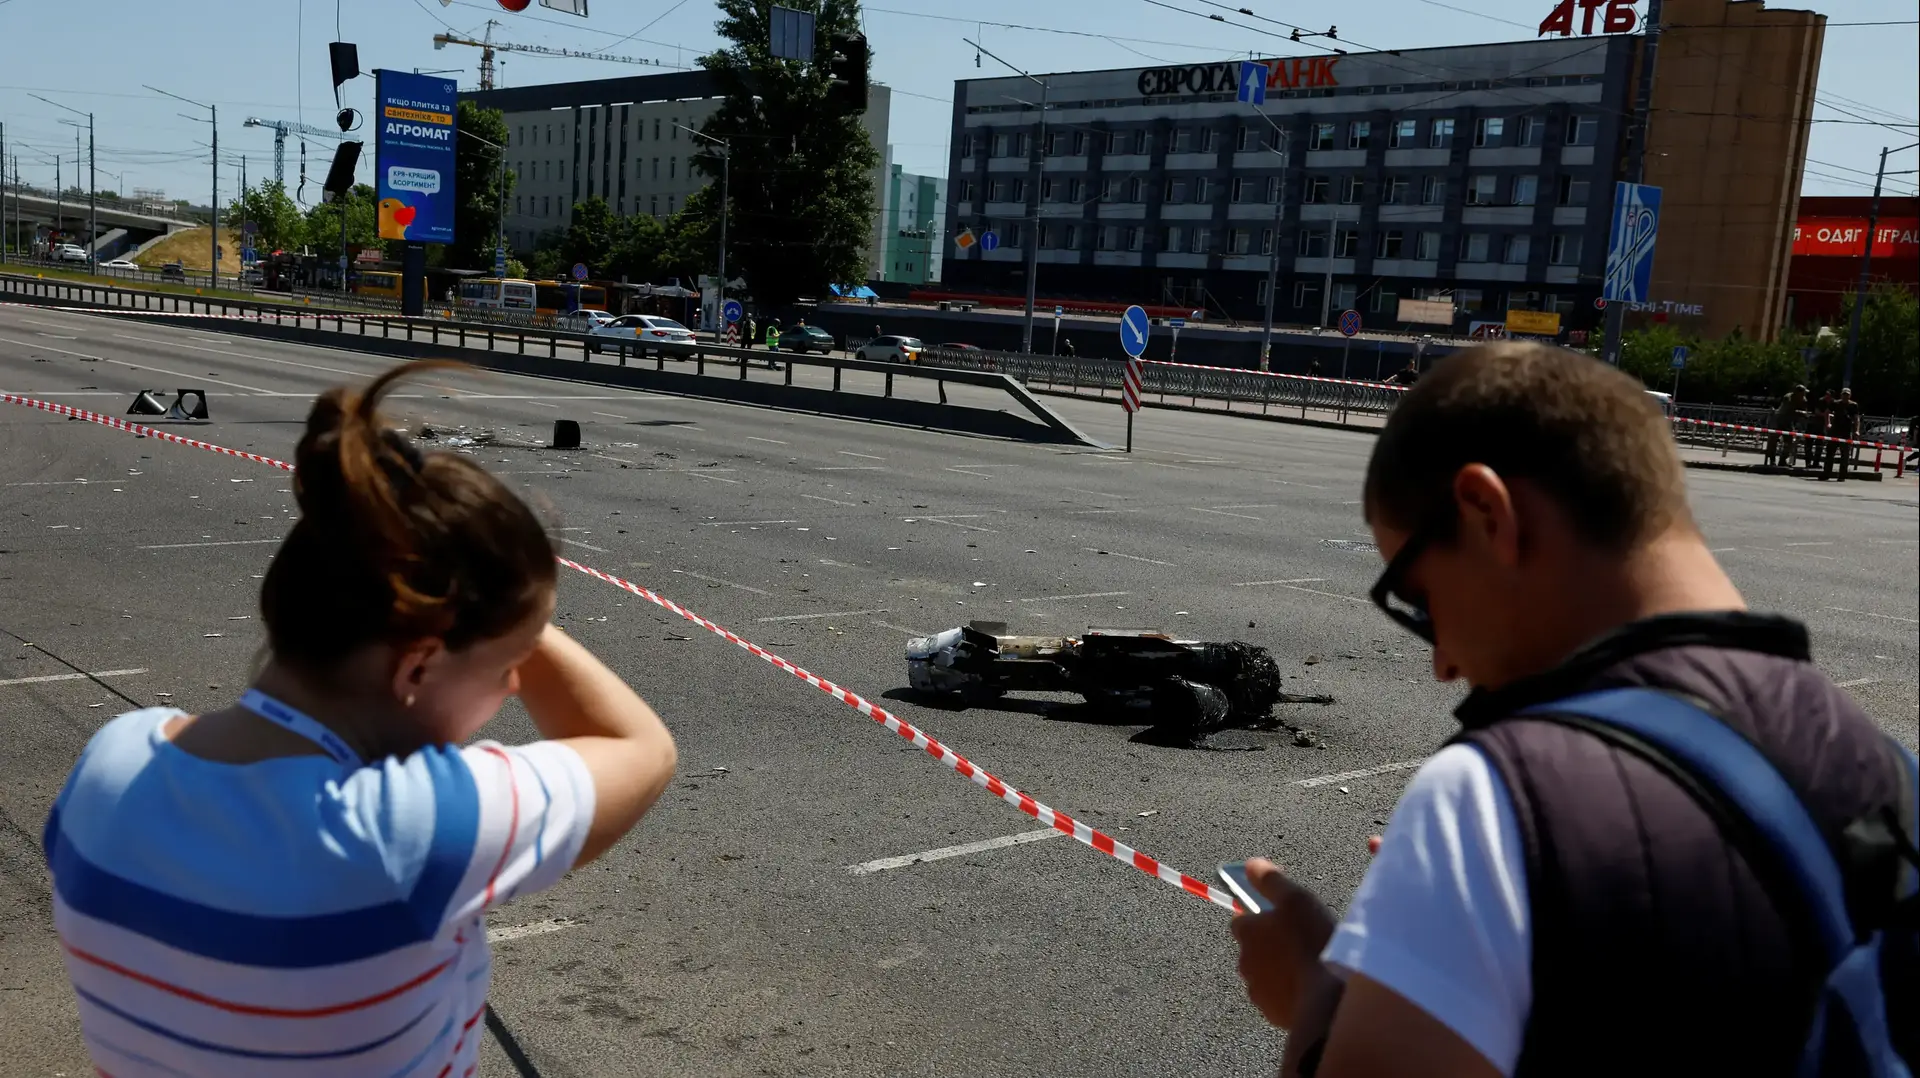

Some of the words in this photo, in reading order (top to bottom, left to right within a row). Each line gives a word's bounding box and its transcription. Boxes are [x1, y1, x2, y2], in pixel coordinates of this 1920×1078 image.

[1538, 0, 1639, 38] АТБ
[1138, 57, 1339, 95] ЄВРОГААНК
[387, 97, 410, 107] якщо
[411, 100, 440, 111] плитка
[441, 104, 451, 112] та
[387, 108, 434, 122] сантехніка,
[386, 122, 451, 141] АГРОМАТ
[393, 170, 436, 181] КРЯ-КРЯЩИЙ
[393, 179, 436, 189] АСОРТИМЕНТ
[1816, 227, 1863, 244] ОДЯГ
[1629, 300, 1704, 316] SHI-TIME
